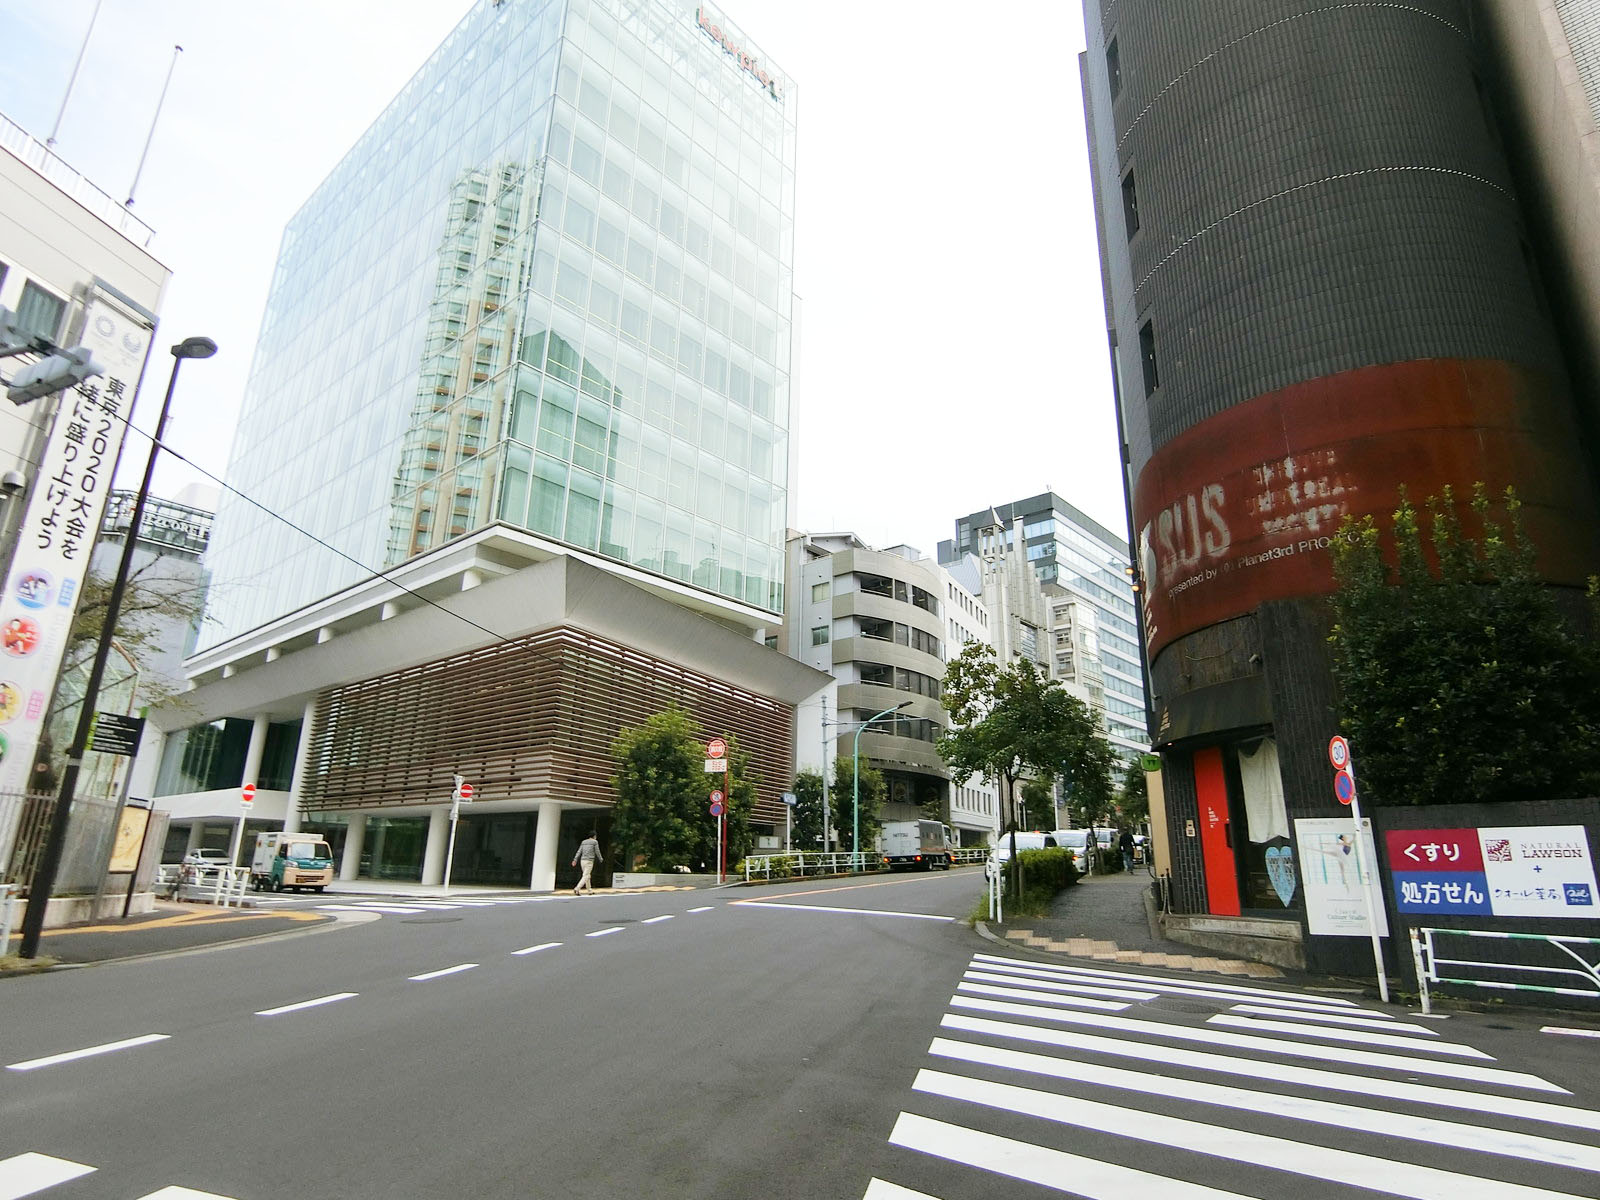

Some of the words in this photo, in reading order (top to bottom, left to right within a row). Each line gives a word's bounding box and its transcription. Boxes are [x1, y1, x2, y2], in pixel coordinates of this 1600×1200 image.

[60, 375, 127, 560] 東京2020大会を
[1205, 568, 1217, 581] by
[1239, 543, 1295, 568] Planet3rd
[1333, 745, 1344, 760] 30
[1403, 843, 1459, 862] くすり
[1522, 849, 1583, 858] LAWSON
[1401, 880, 1484, 904] 処方せん
